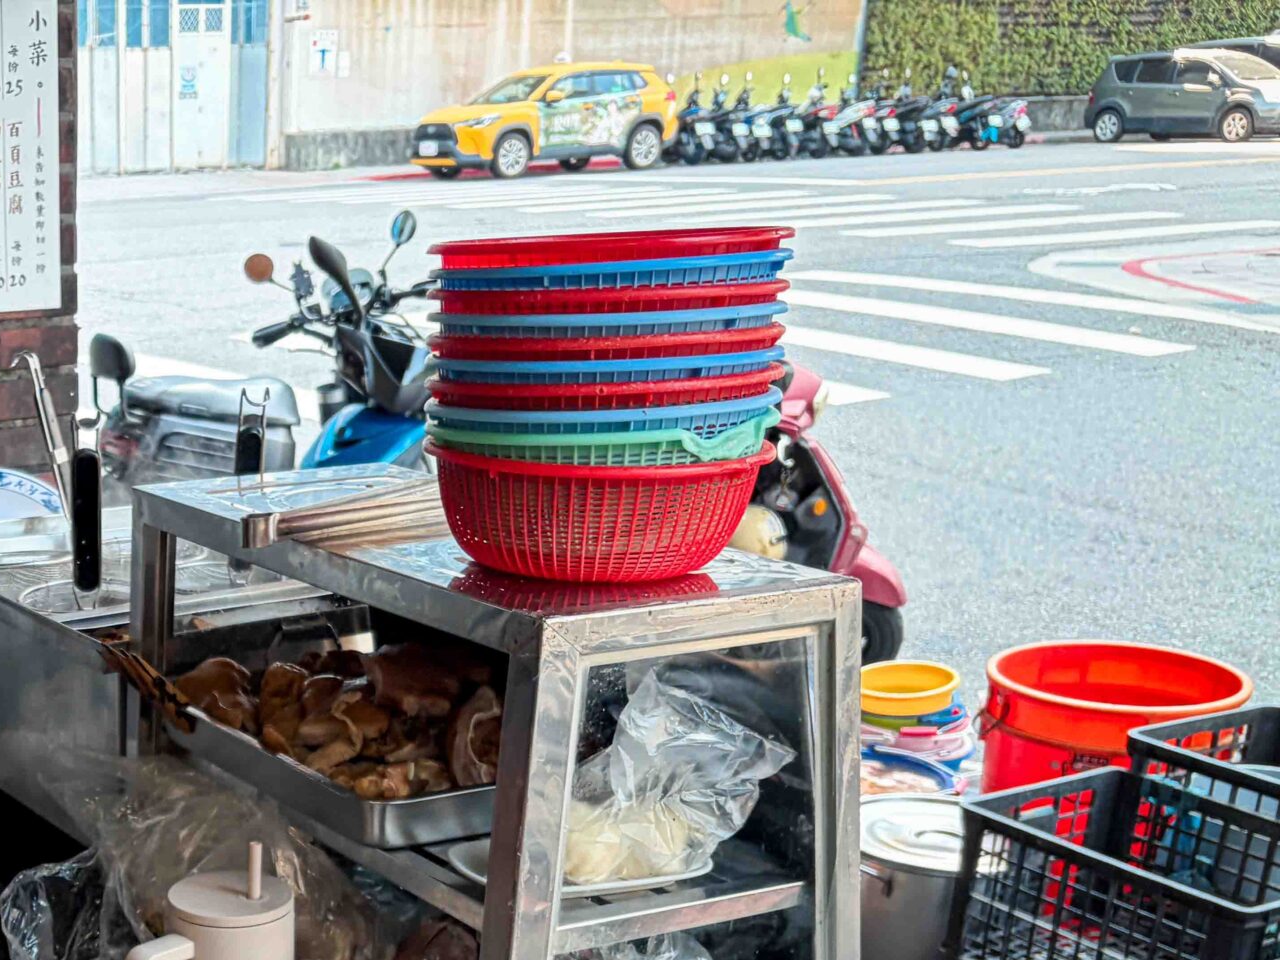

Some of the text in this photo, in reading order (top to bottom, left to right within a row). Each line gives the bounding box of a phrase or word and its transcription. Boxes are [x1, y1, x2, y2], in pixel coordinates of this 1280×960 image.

[28, 9, 48, 67] 小菜
[8, 121, 24, 215] 百頁豆腐
